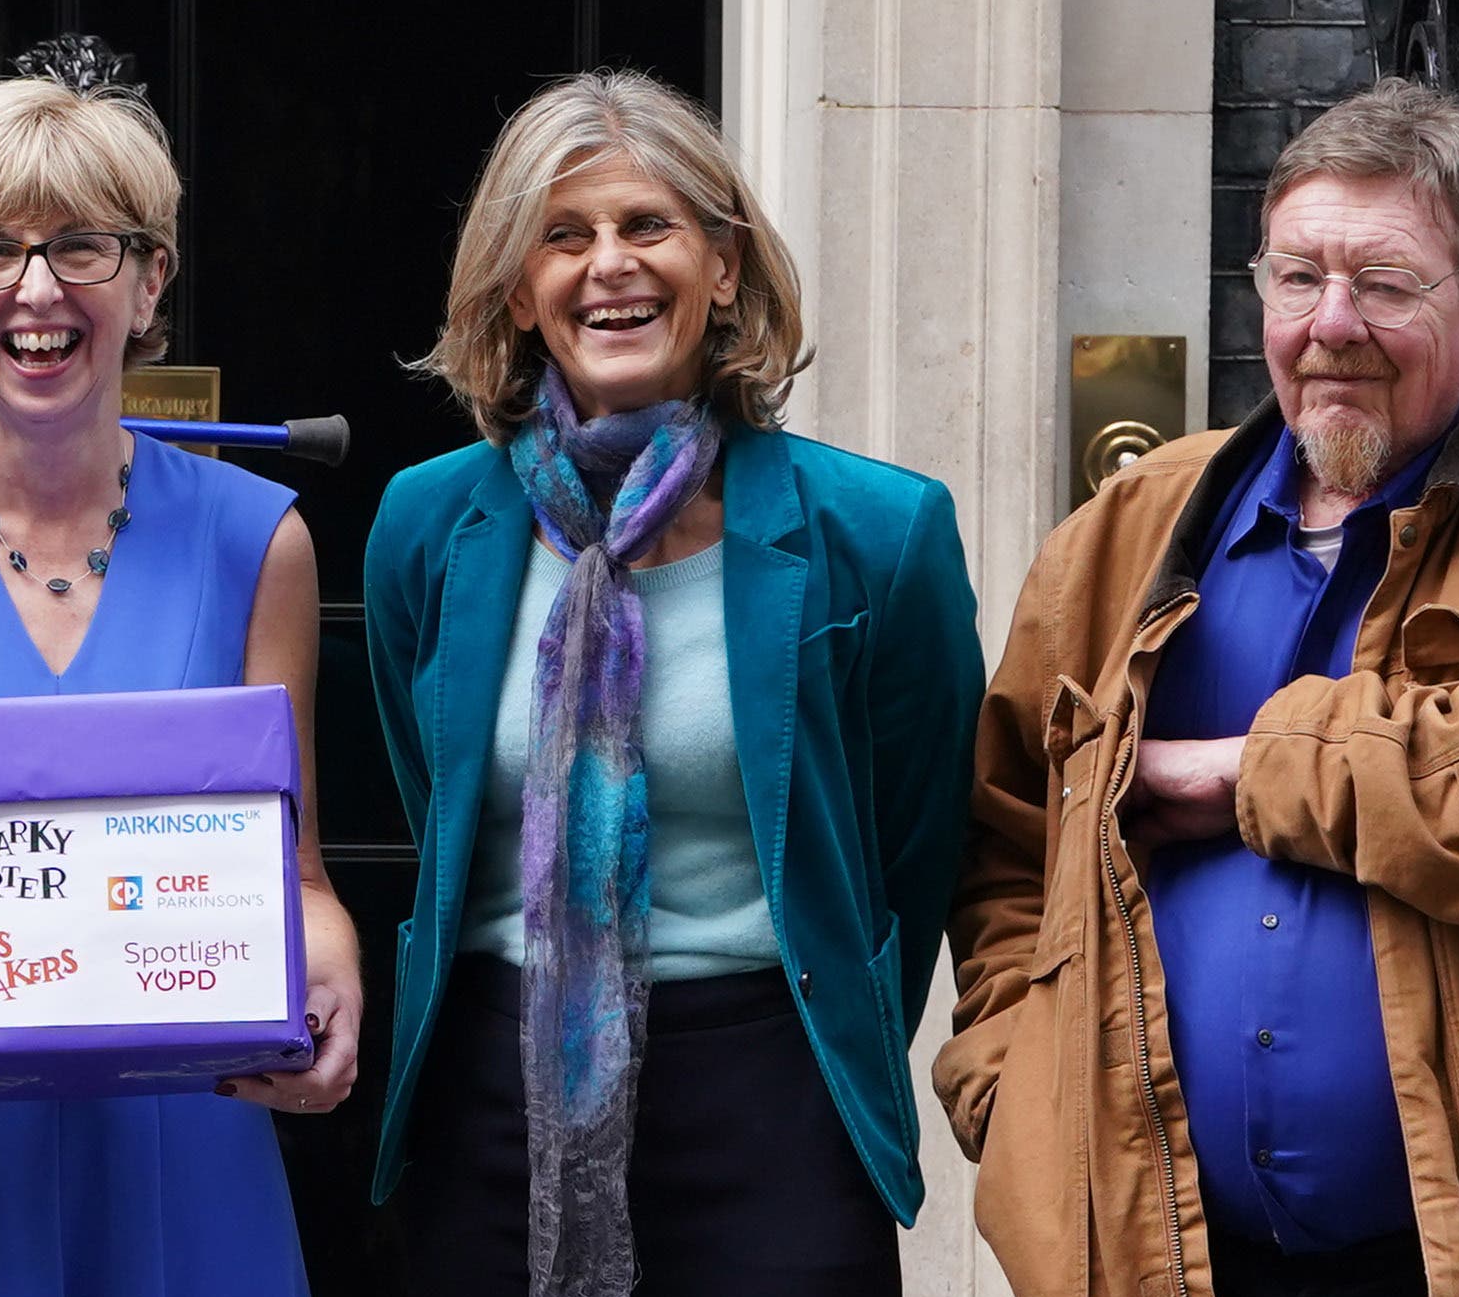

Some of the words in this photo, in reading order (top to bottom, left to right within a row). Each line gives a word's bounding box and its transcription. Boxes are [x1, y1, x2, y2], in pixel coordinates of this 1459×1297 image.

[105, 813, 245, 836] PARKINSON'S
[245, 809, 261, 820] UK
[156, 875, 209, 893] CURE
[157, 893, 265, 910] PARKINSON'S
[124, 940, 251, 969] Spotlight
[136, 968, 217, 992] YOPD
